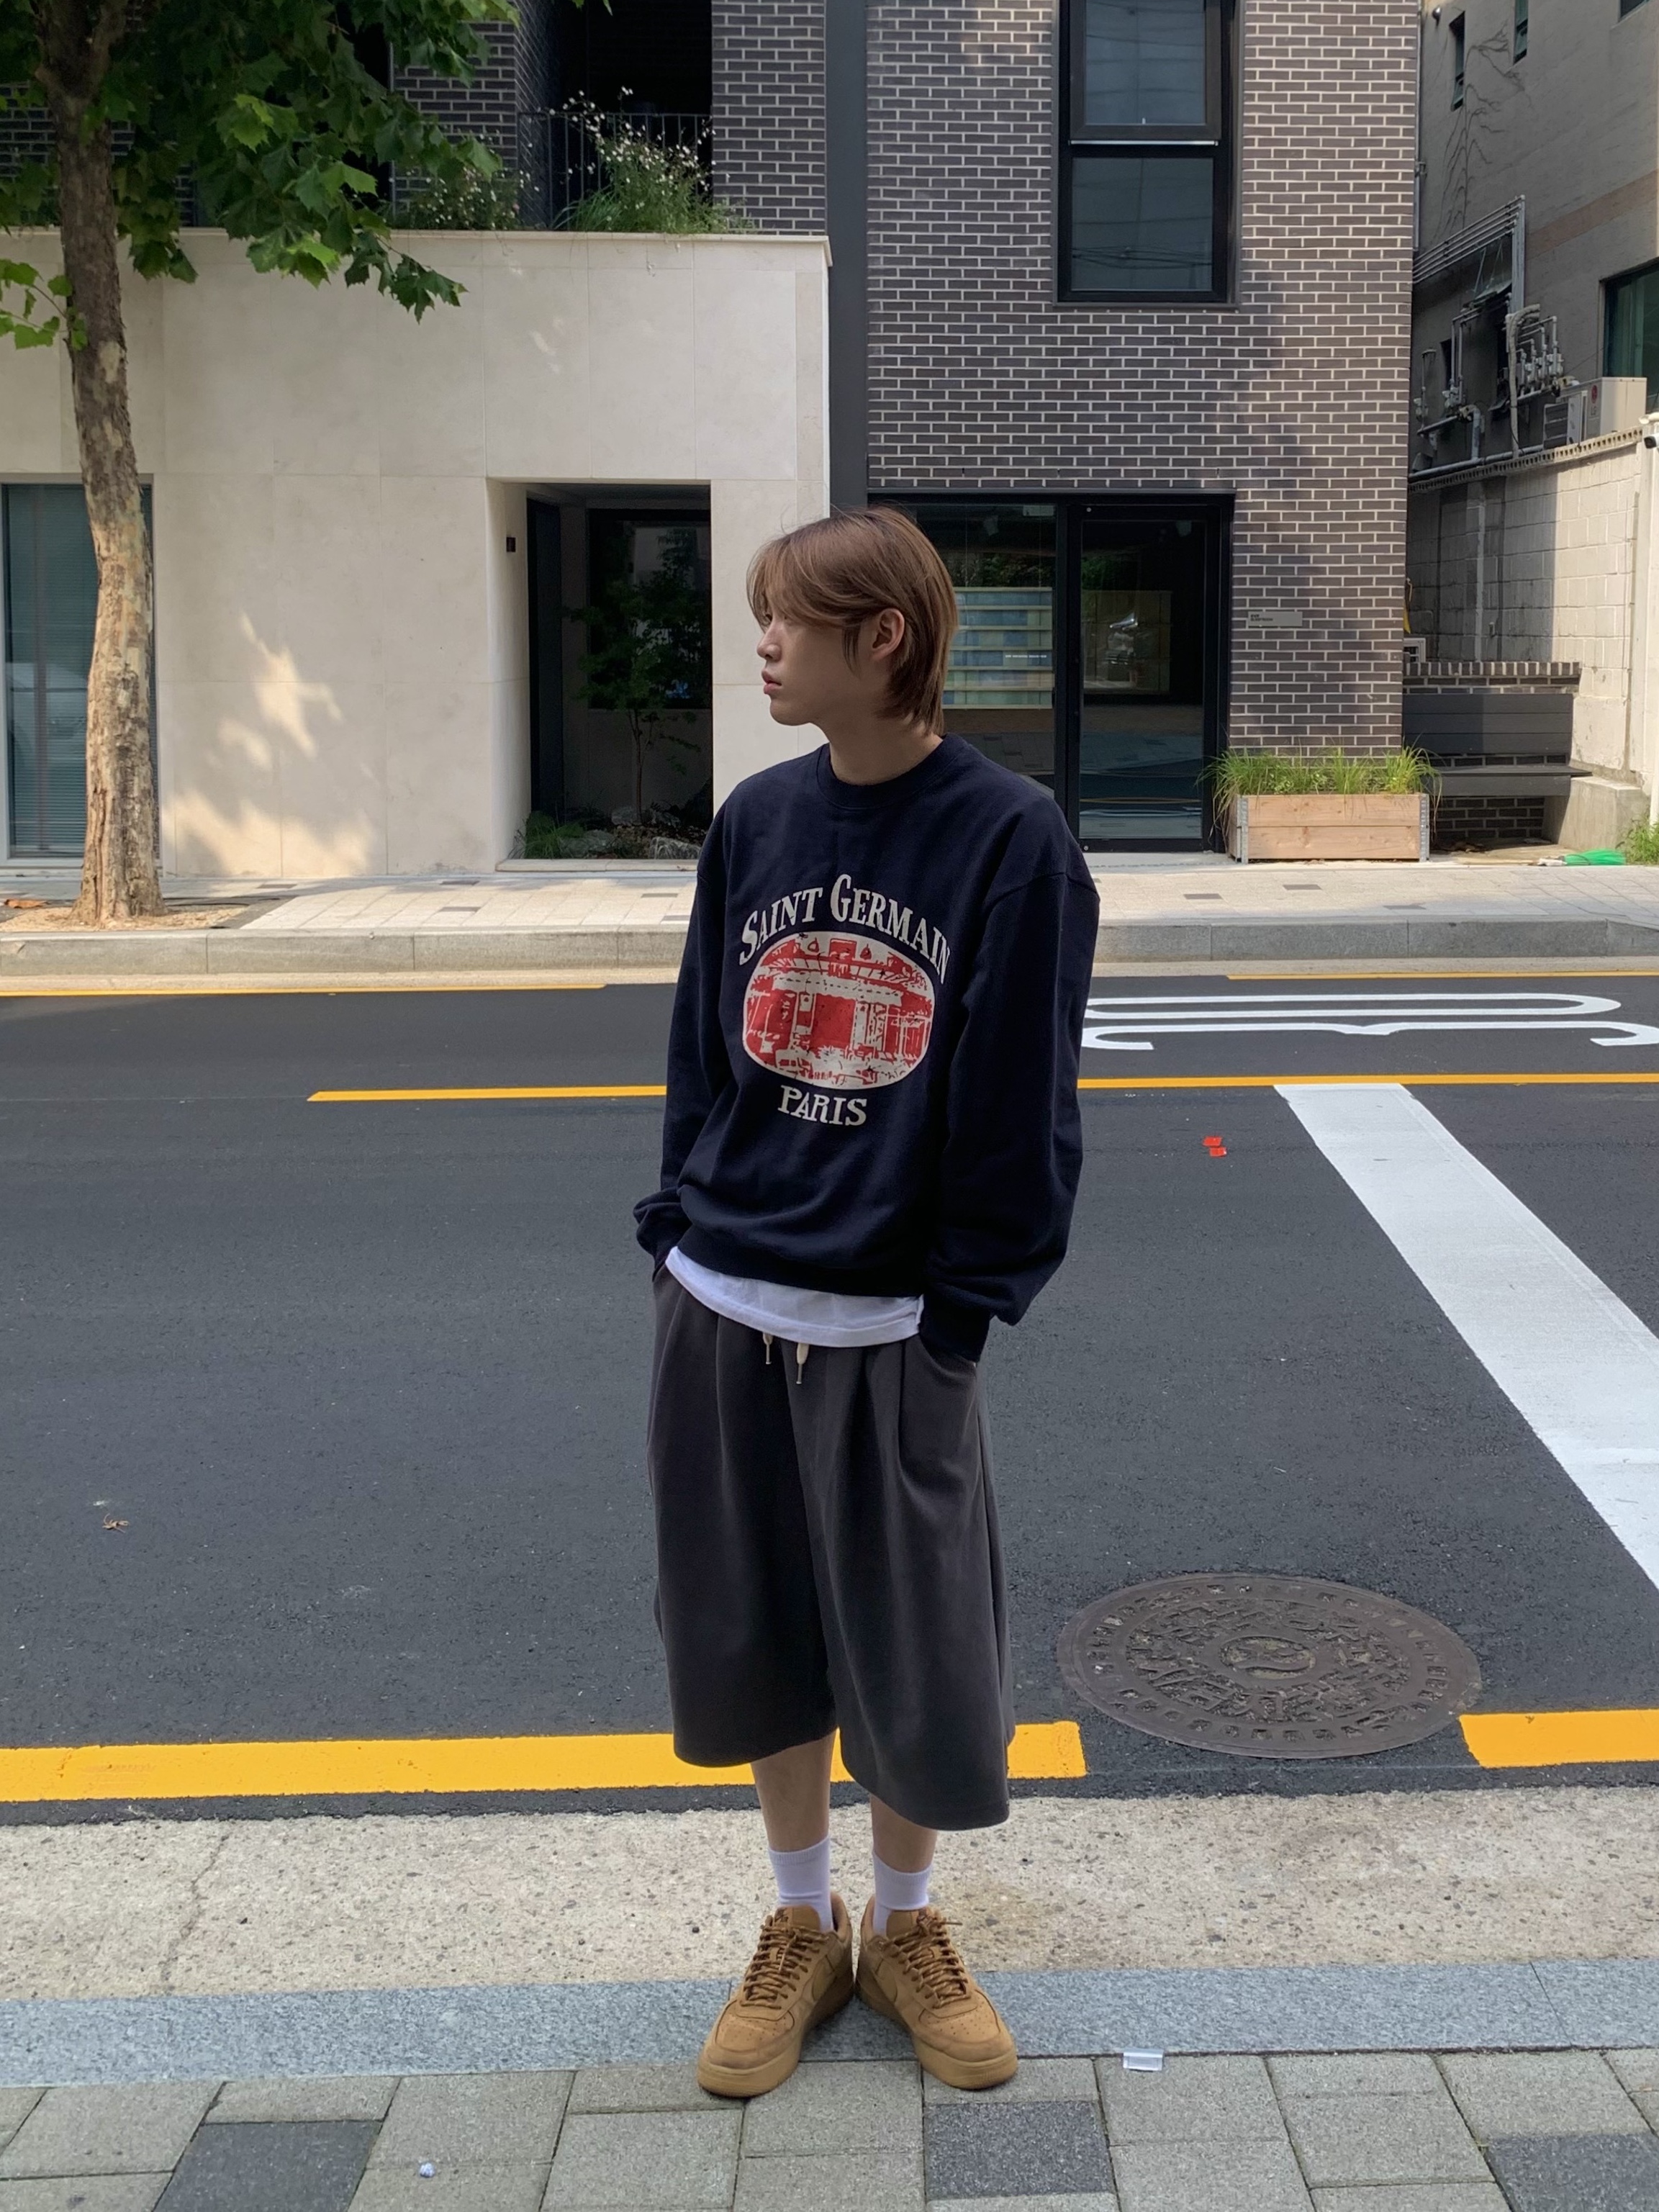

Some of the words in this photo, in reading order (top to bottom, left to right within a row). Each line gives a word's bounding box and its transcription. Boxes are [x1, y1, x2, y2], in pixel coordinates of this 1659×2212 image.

[738, 887, 823, 966] SAINT
[830, 873, 951, 985] GERMAIN
[777, 1084, 867, 1126] PARIS
